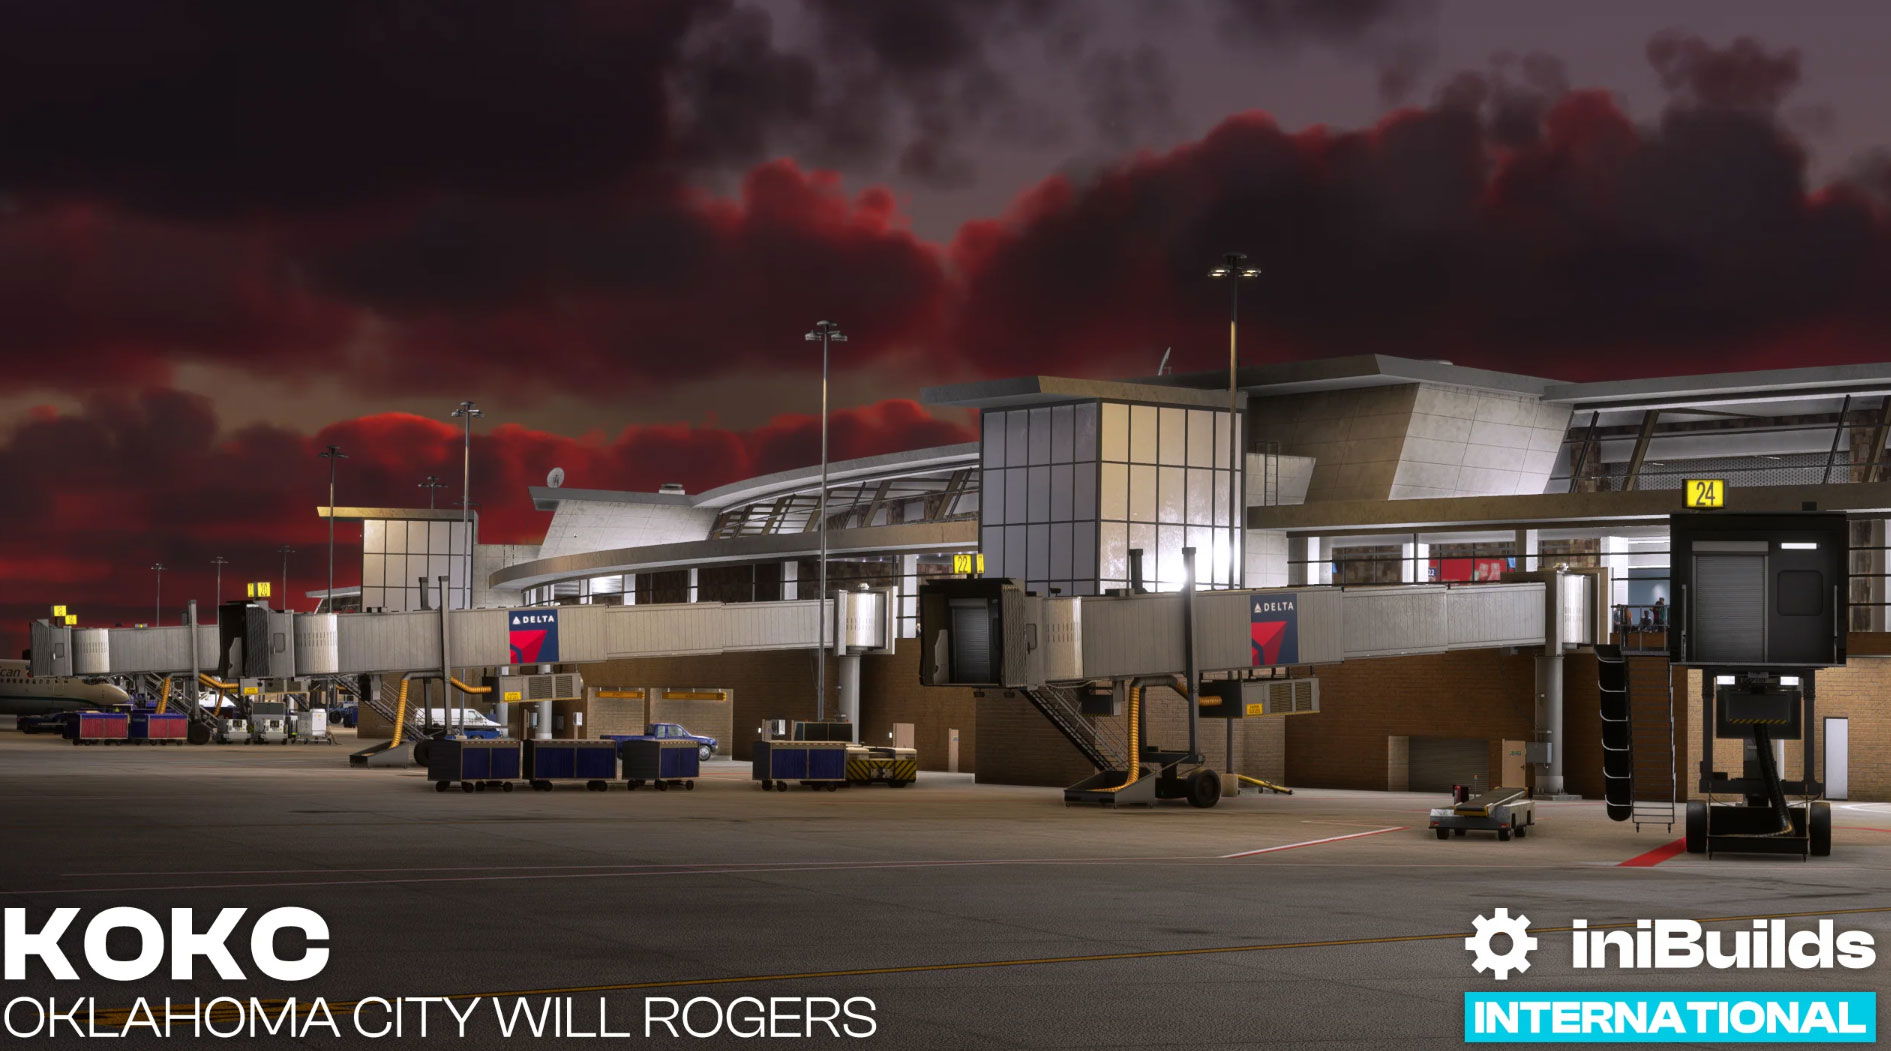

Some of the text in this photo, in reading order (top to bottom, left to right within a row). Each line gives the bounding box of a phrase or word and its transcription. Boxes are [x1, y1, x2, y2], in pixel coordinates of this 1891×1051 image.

[1696, 481, 1716, 506] 24
[958, 555, 968, 573] 22
[1264, 601, 1294, 612] DELTA
[523, 615, 555, 624] DELTA
[0, 667, 21, 677] can
